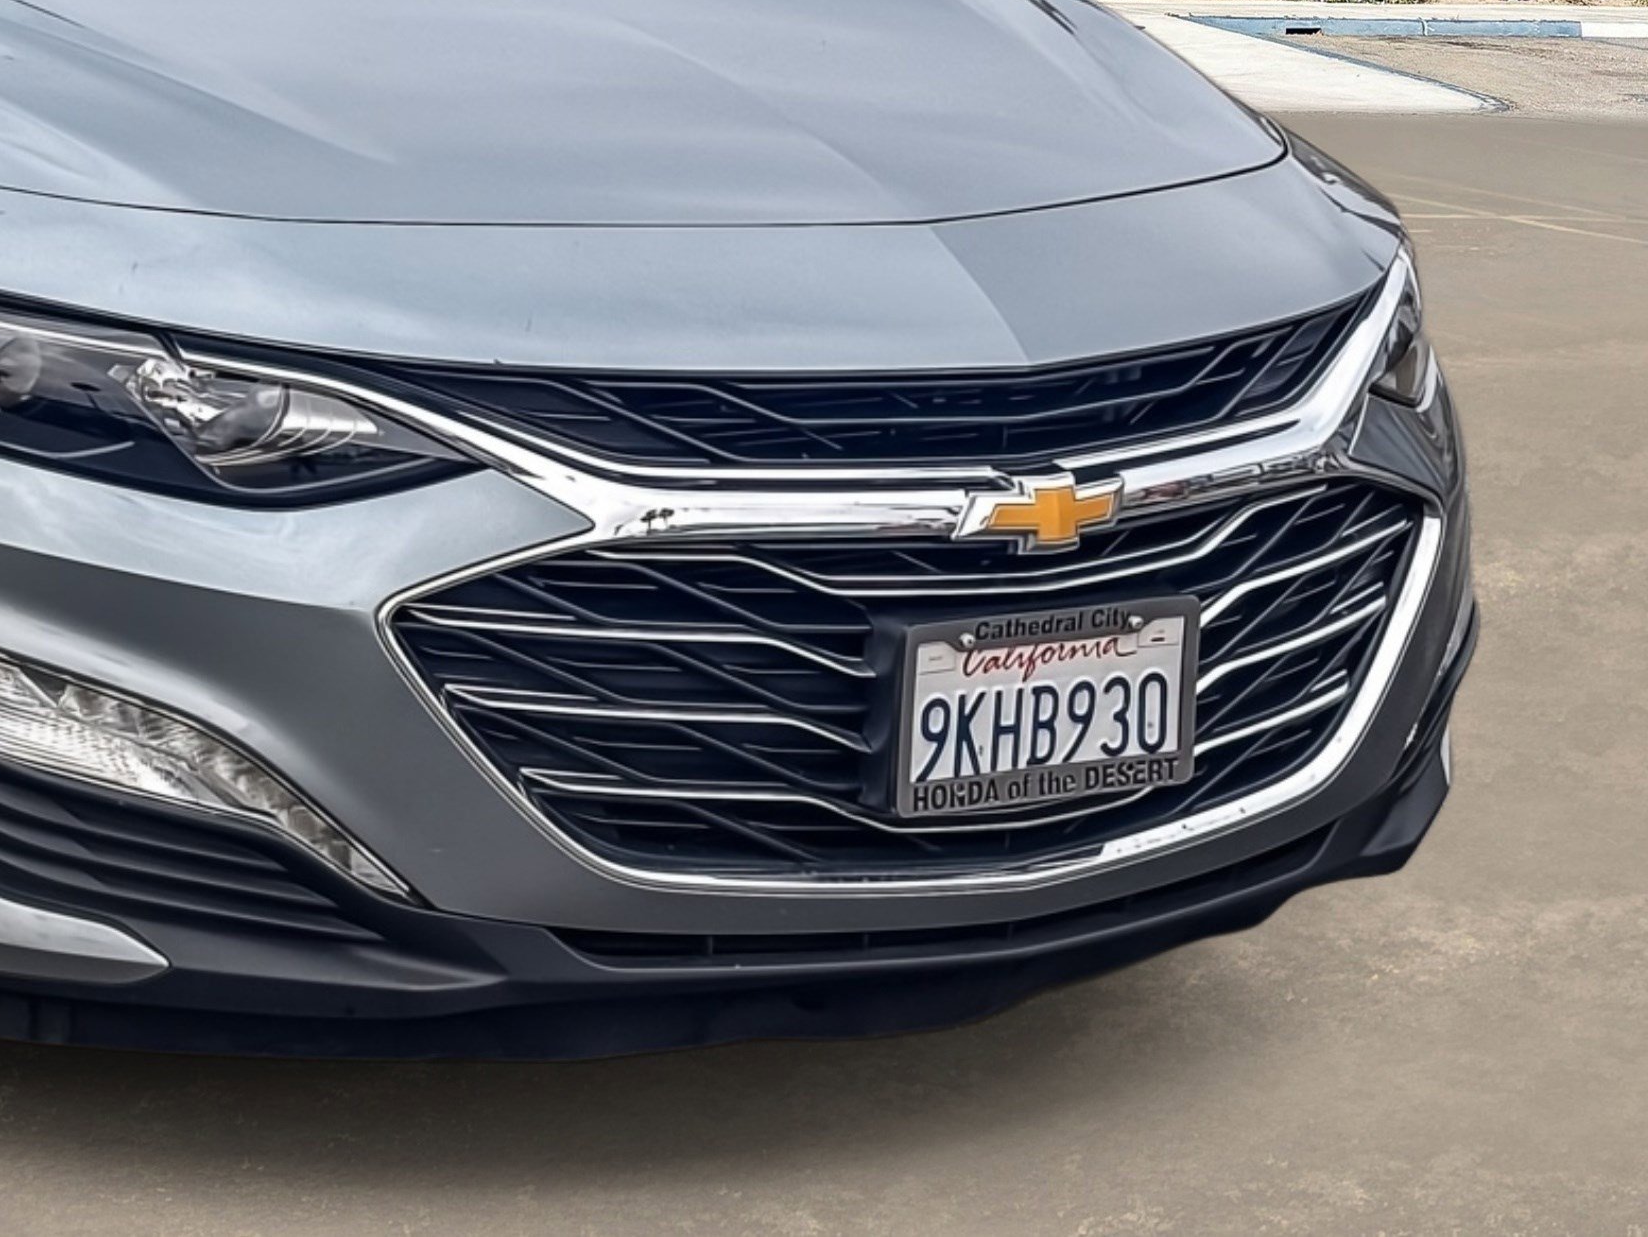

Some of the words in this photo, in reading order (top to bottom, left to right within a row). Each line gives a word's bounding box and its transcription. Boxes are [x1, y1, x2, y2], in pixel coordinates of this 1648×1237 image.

[974, 612, 1084, 641] Cathedral
[1090, 608, 1131, 631] City
[962, 636, 1137, 681] California
[915, 670, 1168, 783] 9KHB930
[912, 779, 1000, 812] HONDA
[1007, 774, 1031, 799] of
[1036, 767, 1077, 795] the
[1084, 757, 1179, 790] DESERT
